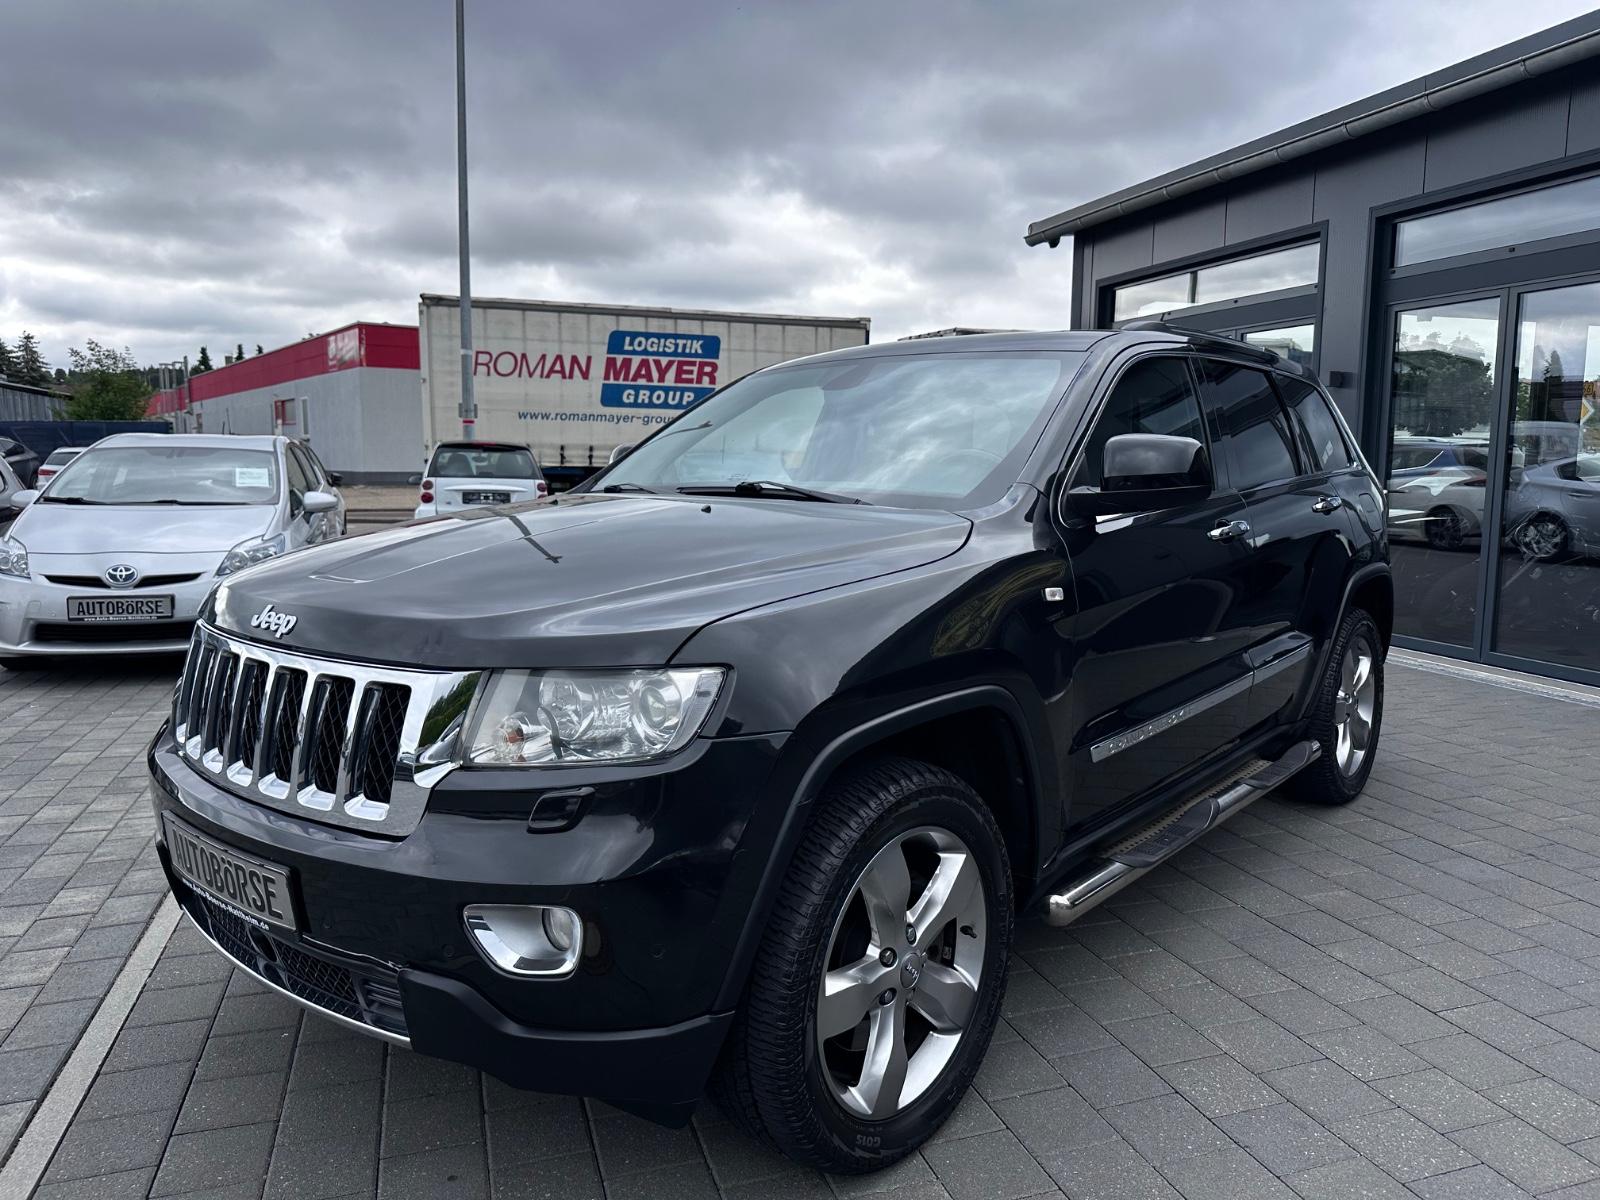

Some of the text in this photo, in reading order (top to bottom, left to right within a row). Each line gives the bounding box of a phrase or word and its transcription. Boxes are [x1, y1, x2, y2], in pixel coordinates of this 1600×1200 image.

[624, 336, 703, 354] LOGISTIK
[473, 350, 719, 386] ROMAN MAYER
[622, 389, 695, 406] GROUP
[77, 600, 164, 615] AUTOBÖRSE
[250, 604, 297, 638] Jeep
[172, 828, 283, 920] AUTOBÖRSE
